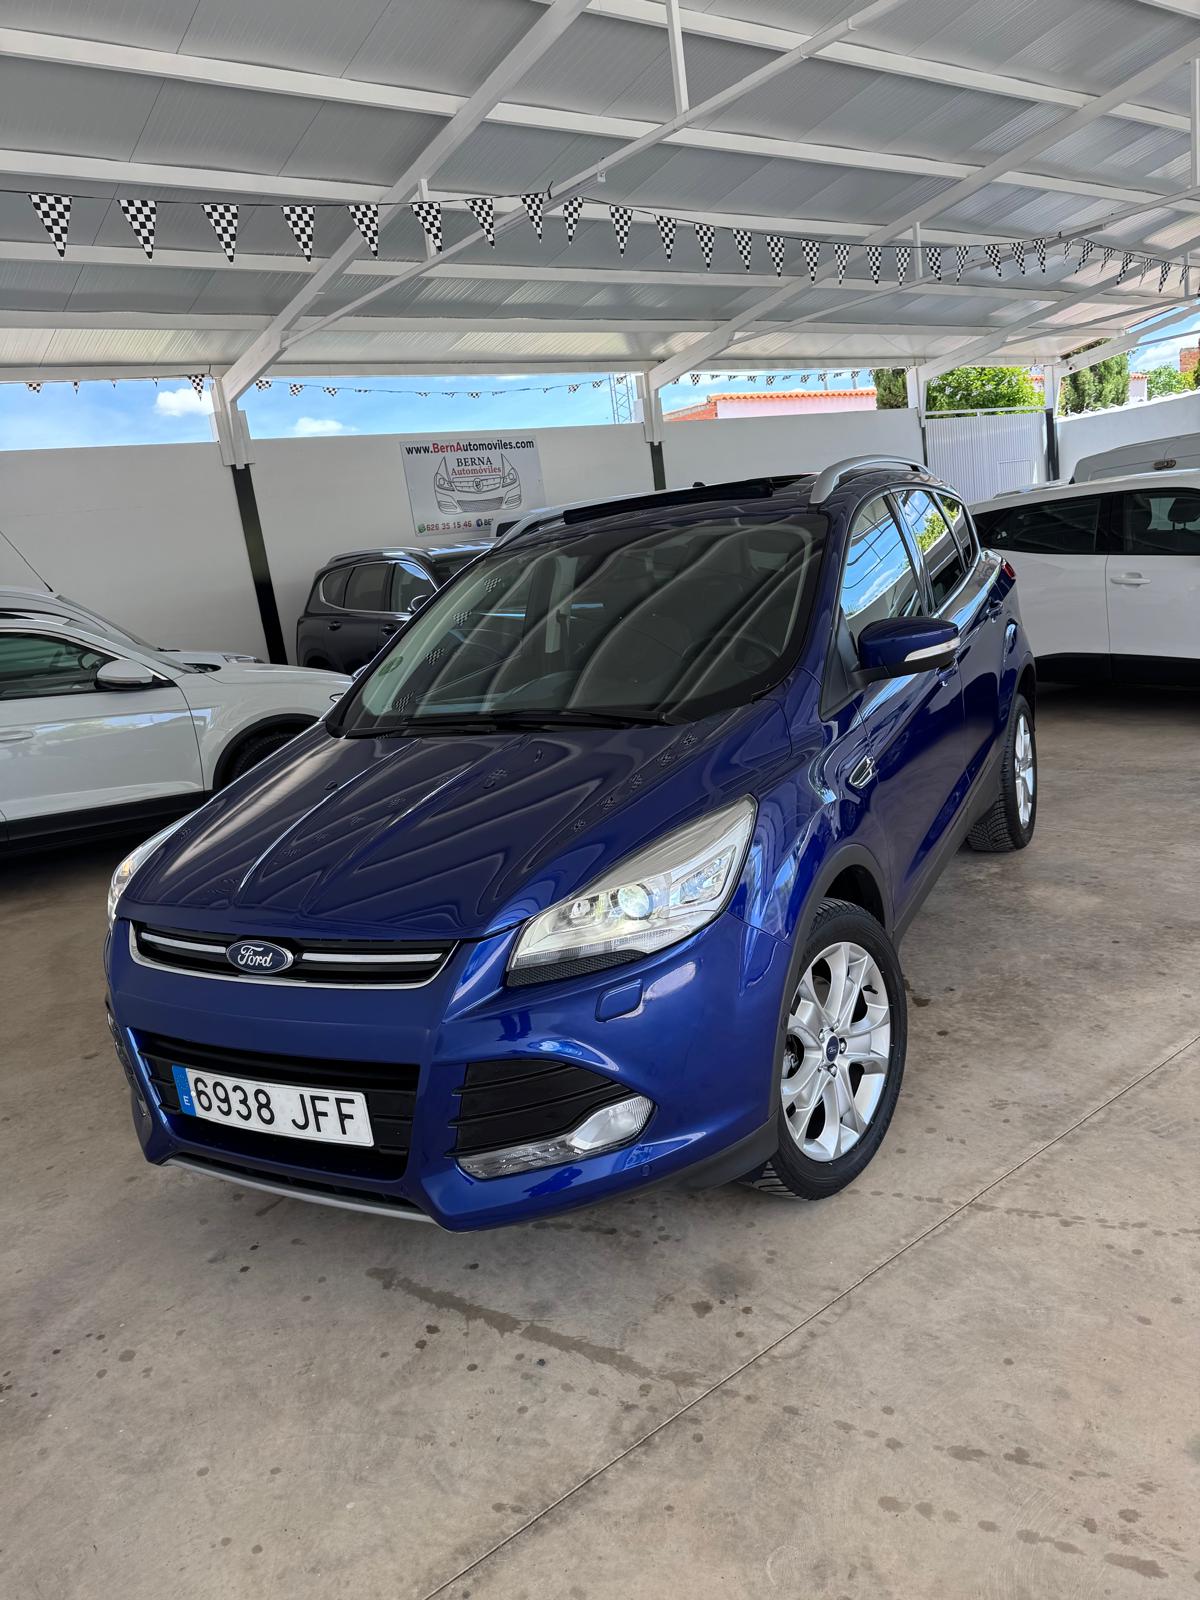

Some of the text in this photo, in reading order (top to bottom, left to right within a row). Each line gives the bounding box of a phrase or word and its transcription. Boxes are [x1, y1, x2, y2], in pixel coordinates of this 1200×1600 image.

[405, 439, 535, 455] www.BernAutomoviles.com
[456, 456, 493, 467] BERNA
[451, 465, 502, 476] Automóviles
[441, 522, 451, 530] 35
[453, 521, 461, 529] 15
[484, 518, 494, 526] BE
[237, 945, 273, 967] Ford
[184, 1095, 190, 1106] E
[193, 1077, 356, 1135] 6938 JFF
